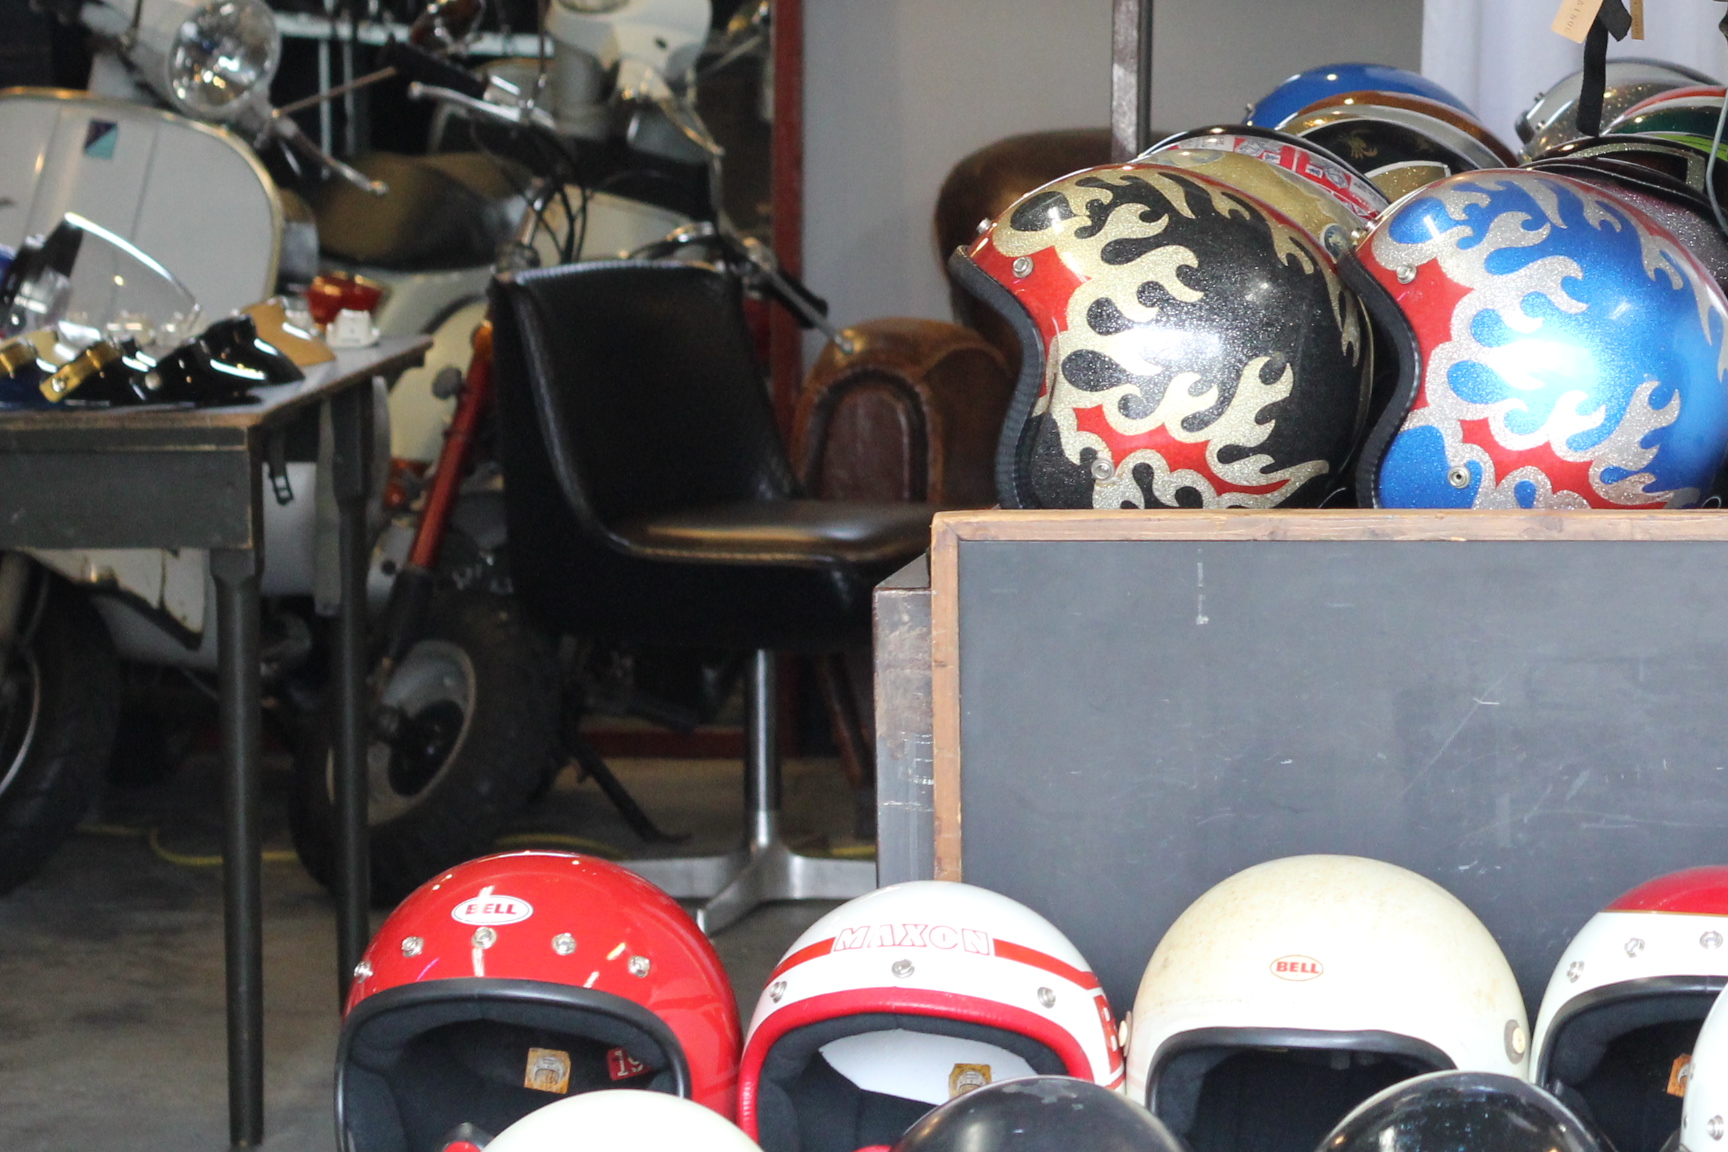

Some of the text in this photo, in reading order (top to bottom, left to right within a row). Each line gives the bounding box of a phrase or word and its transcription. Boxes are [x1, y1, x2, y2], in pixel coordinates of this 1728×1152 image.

[465, 903, 517, 915] BELL
[833, 923, 990, 956] MAXON
[1275, 961, 1321, 974] BELL
